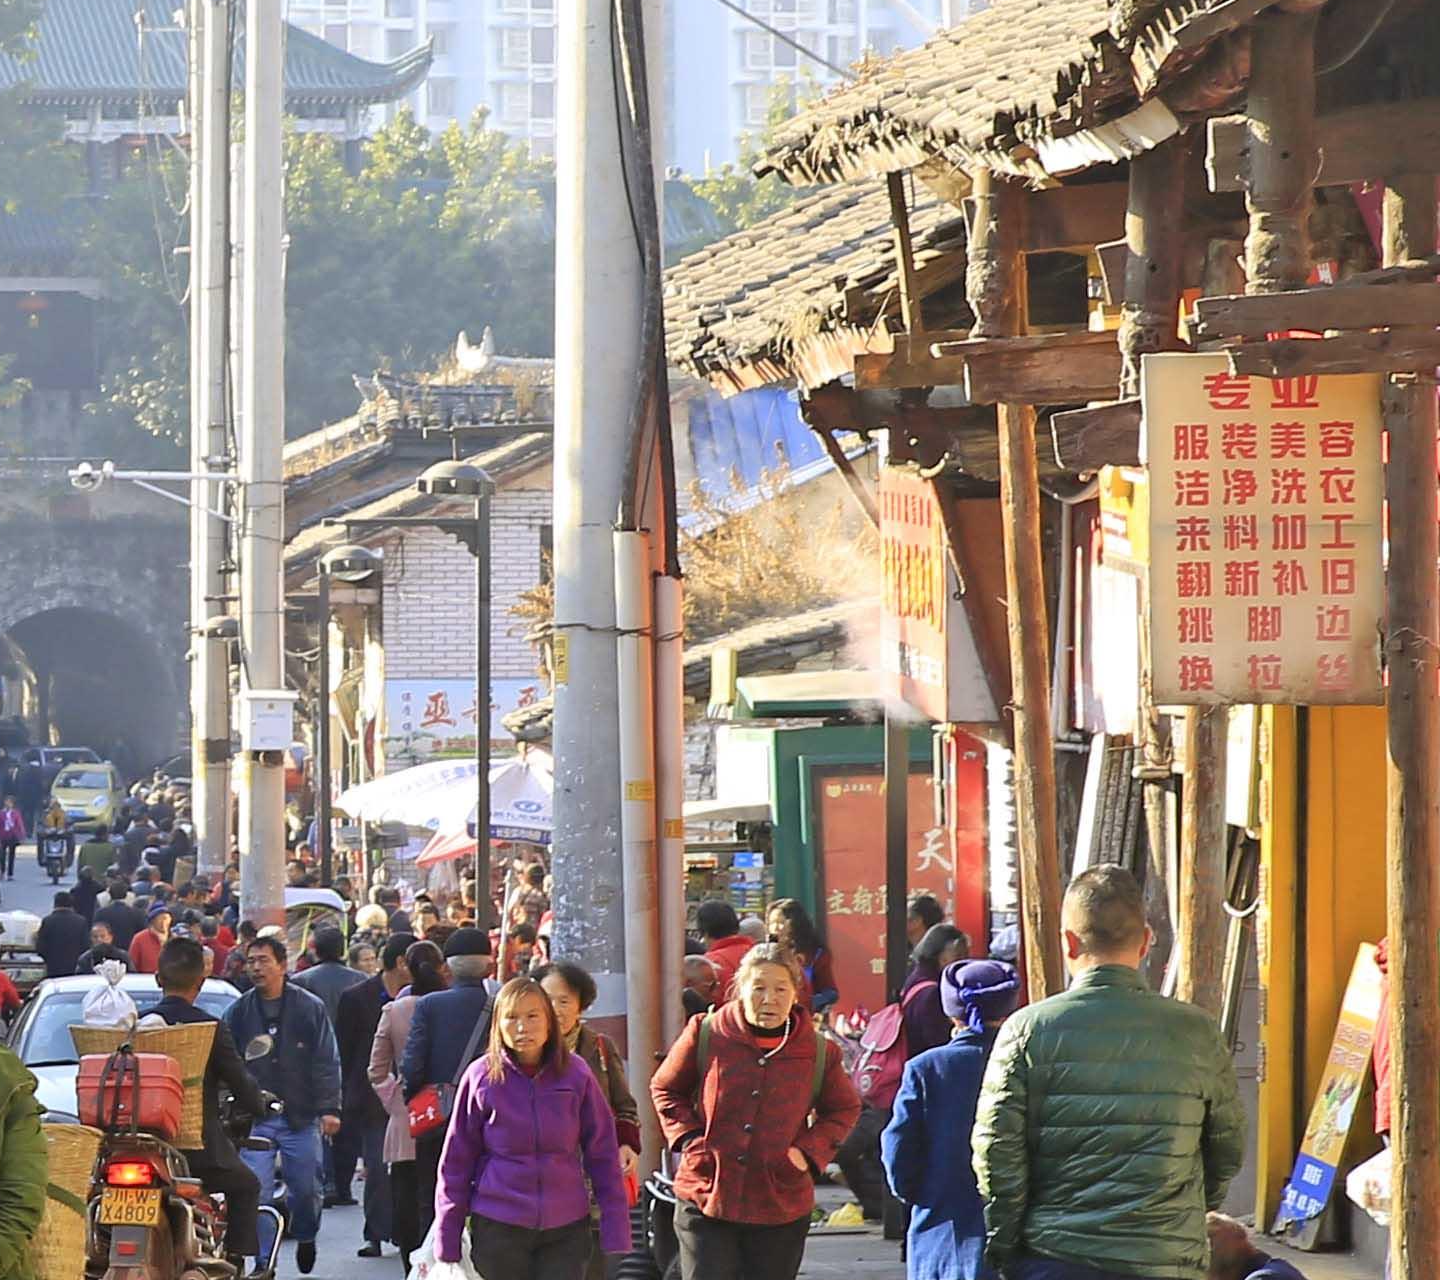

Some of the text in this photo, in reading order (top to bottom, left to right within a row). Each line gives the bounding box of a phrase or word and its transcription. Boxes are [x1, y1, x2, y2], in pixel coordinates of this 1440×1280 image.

[1203, 372, 1319, 410] 专业
[1173, 421, 1355, 461] 服装美容
[1174, 467, 1356, 506] 洁净洗衣
[1175, 514, 1356, 551] 来料加工
[1176, 558, 1356, 598] 翻新补旧
[1178, 605, 1351, 643] 挑脚边
[1178, 654, 1351, 692] 换拉丝
[103, 1205, 156, 1222] X4809
